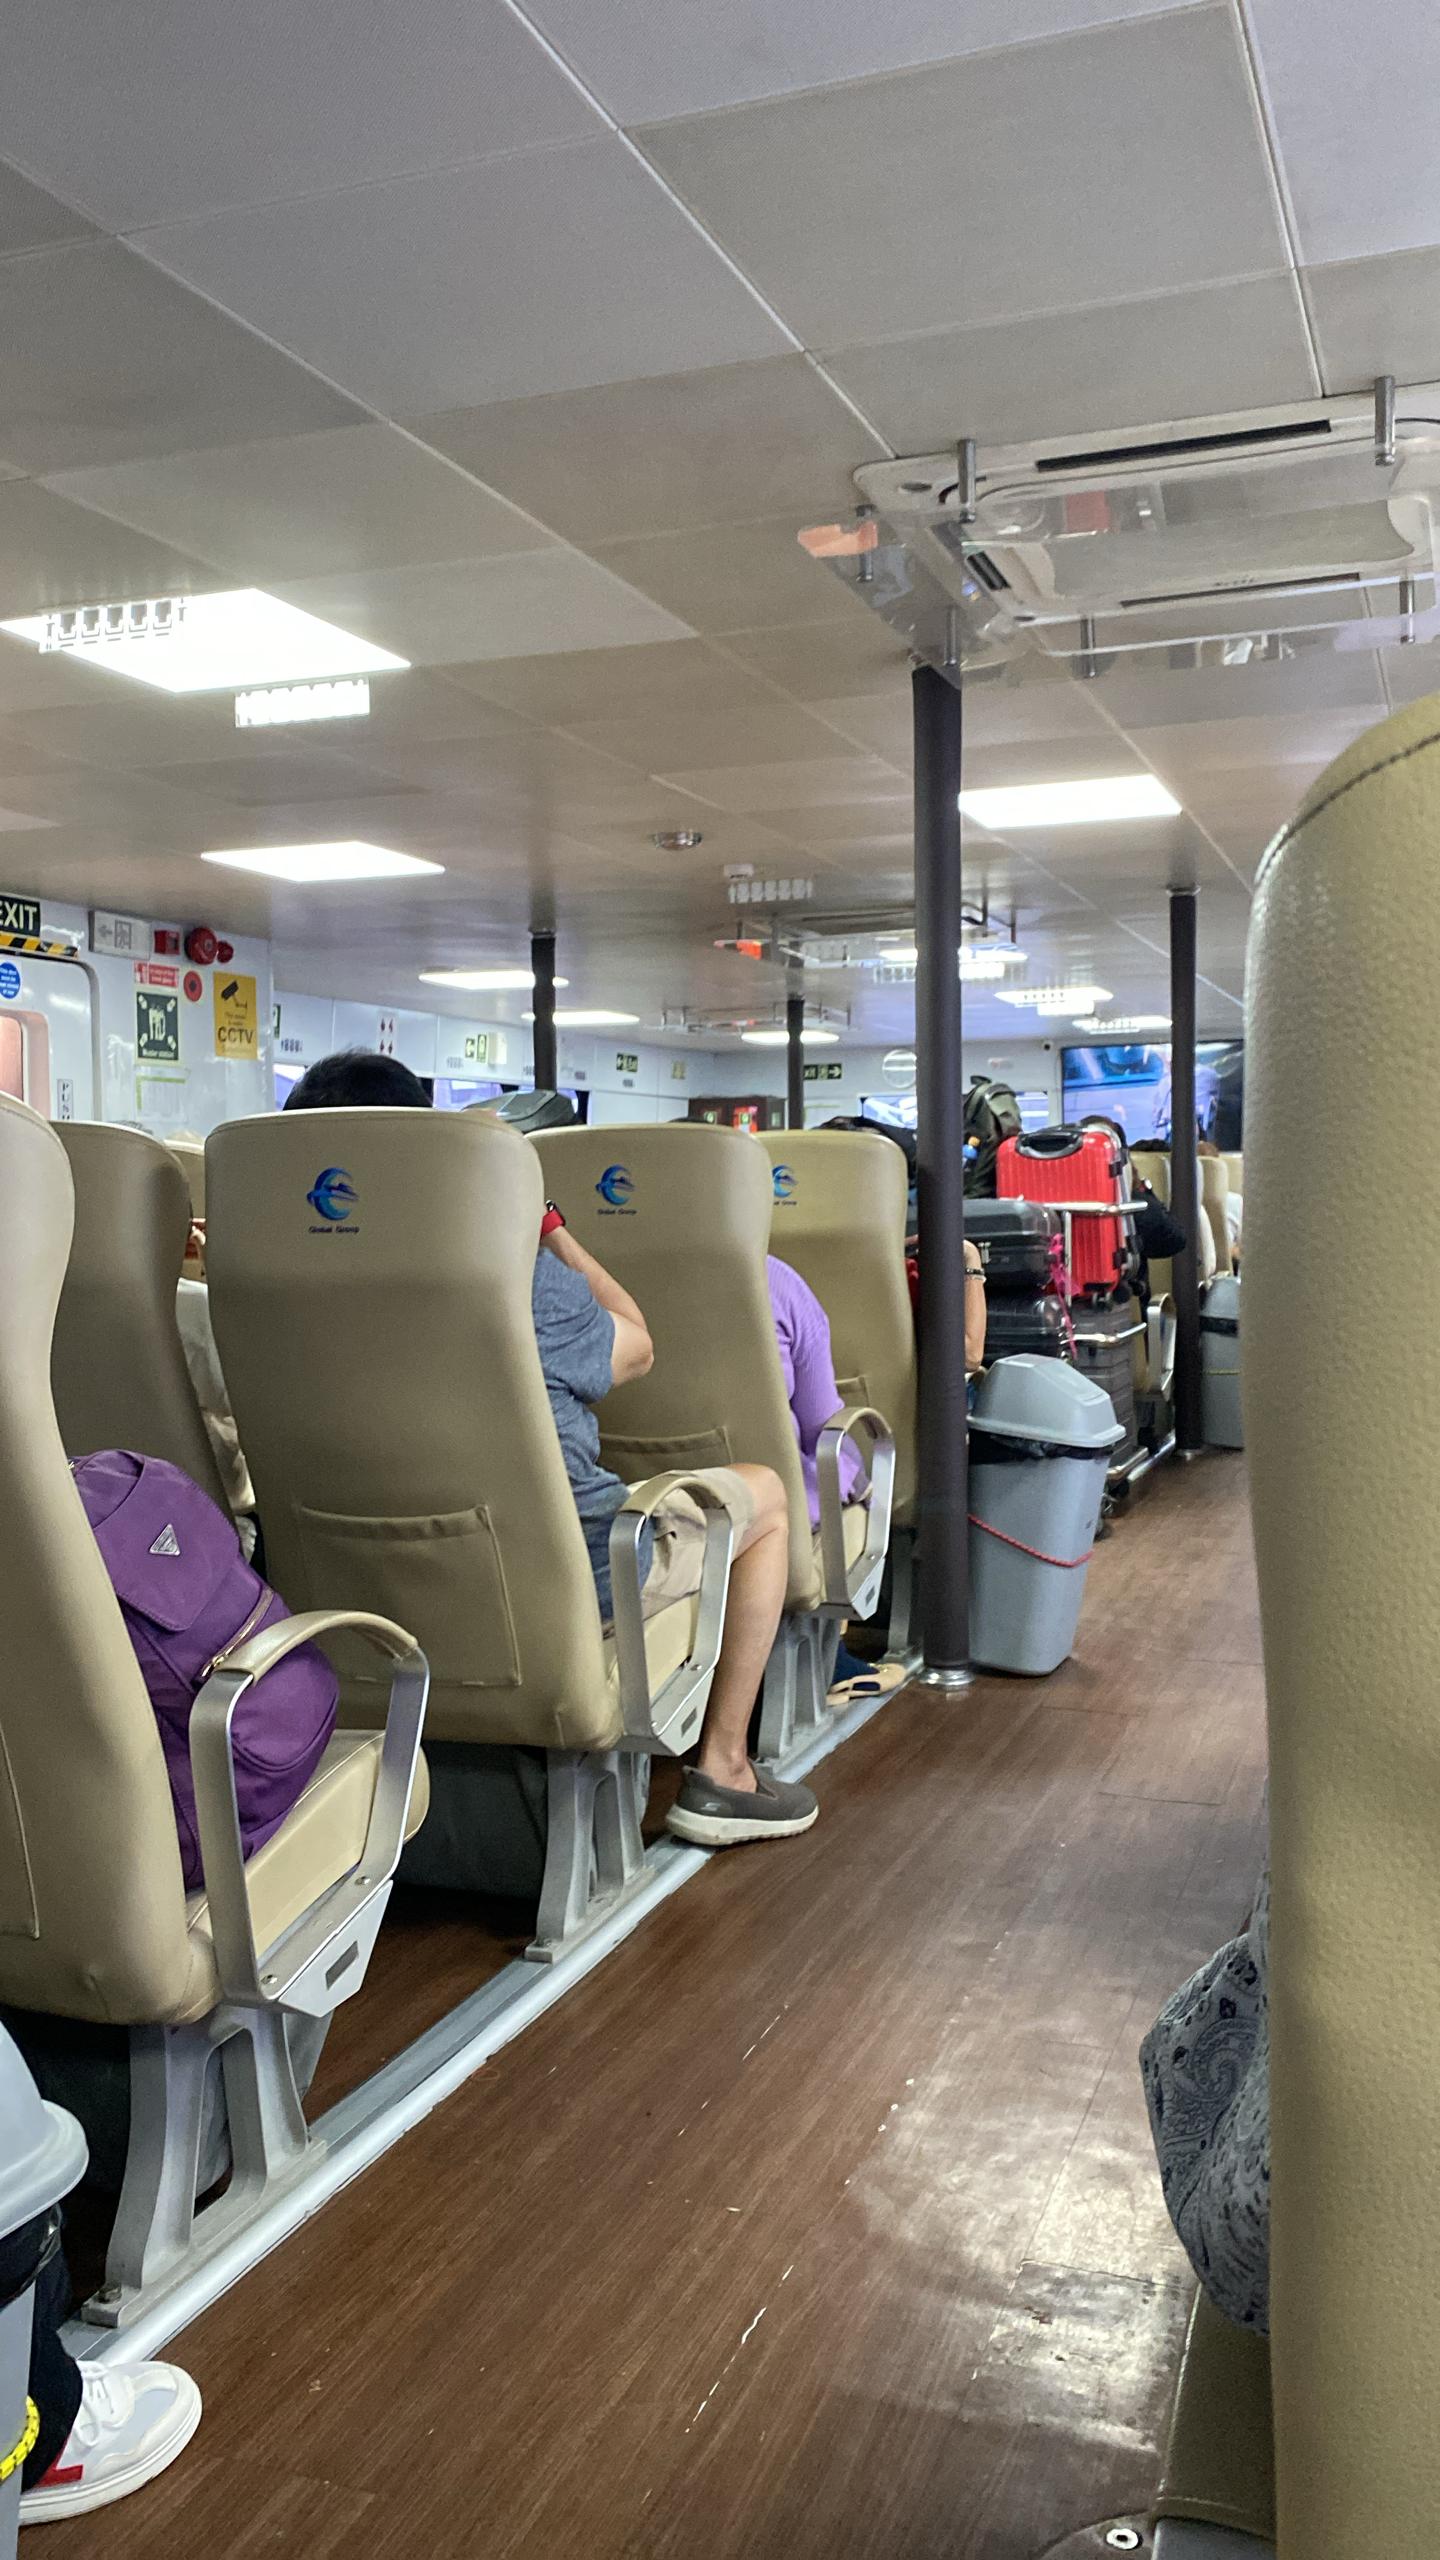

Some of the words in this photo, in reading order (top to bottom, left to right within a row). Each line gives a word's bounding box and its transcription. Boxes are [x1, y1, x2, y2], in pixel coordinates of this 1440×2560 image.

[217, 1026, 254, 1045] CCTV
[308, 1225, 333, 1234] Global
[335, 1225, 360, 1235] Group
